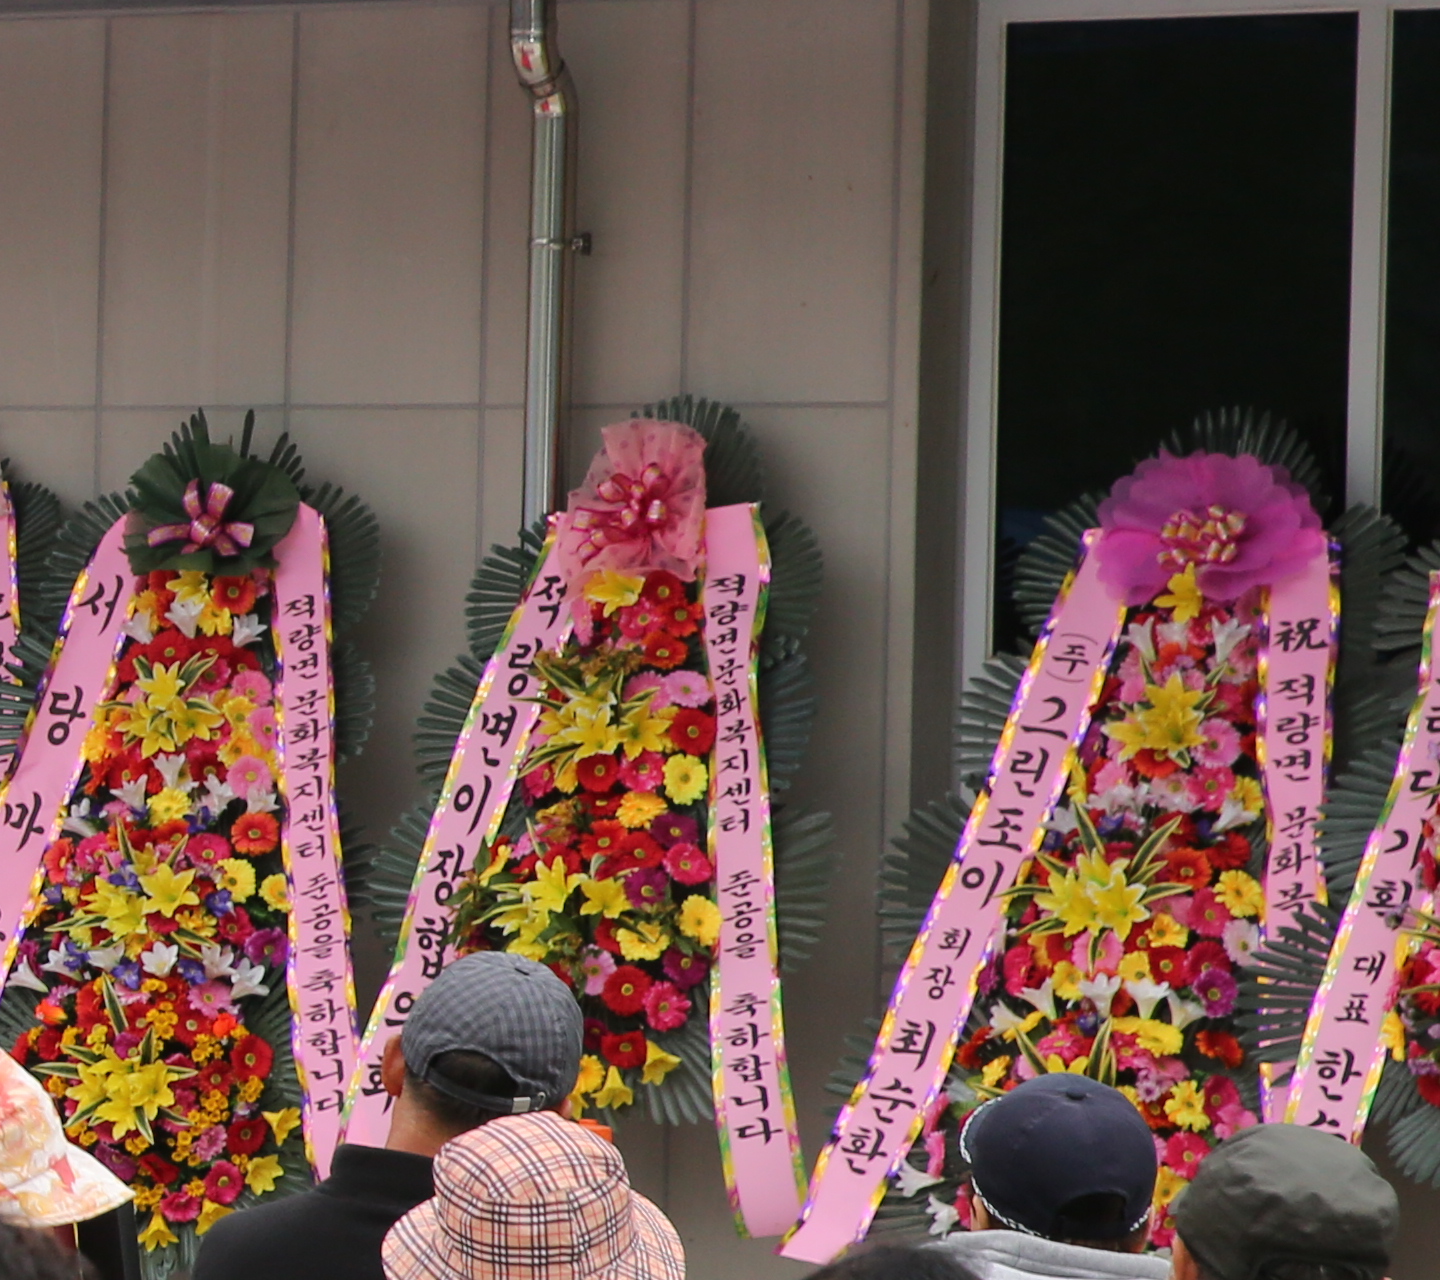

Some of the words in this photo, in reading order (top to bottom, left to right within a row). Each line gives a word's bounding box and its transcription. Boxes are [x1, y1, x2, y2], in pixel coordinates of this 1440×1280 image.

[283, 594, 325, 680] 적량면
[1273, 619, 1328, 653] 祝
[1273, 674, 1320, 782] 적량면
[287, 689, 329, 862] 문화복지센터
[298, 871, 345, 959] 준공을
[721, 869, 767, 960] 준공을
[922, 926, 972, 1001] 회장
[1332, 952, 1386, 1026] 대표
[724, 992, 784, 1146] 축하합니다
[840, 1019, 937, 1176] 최순환
